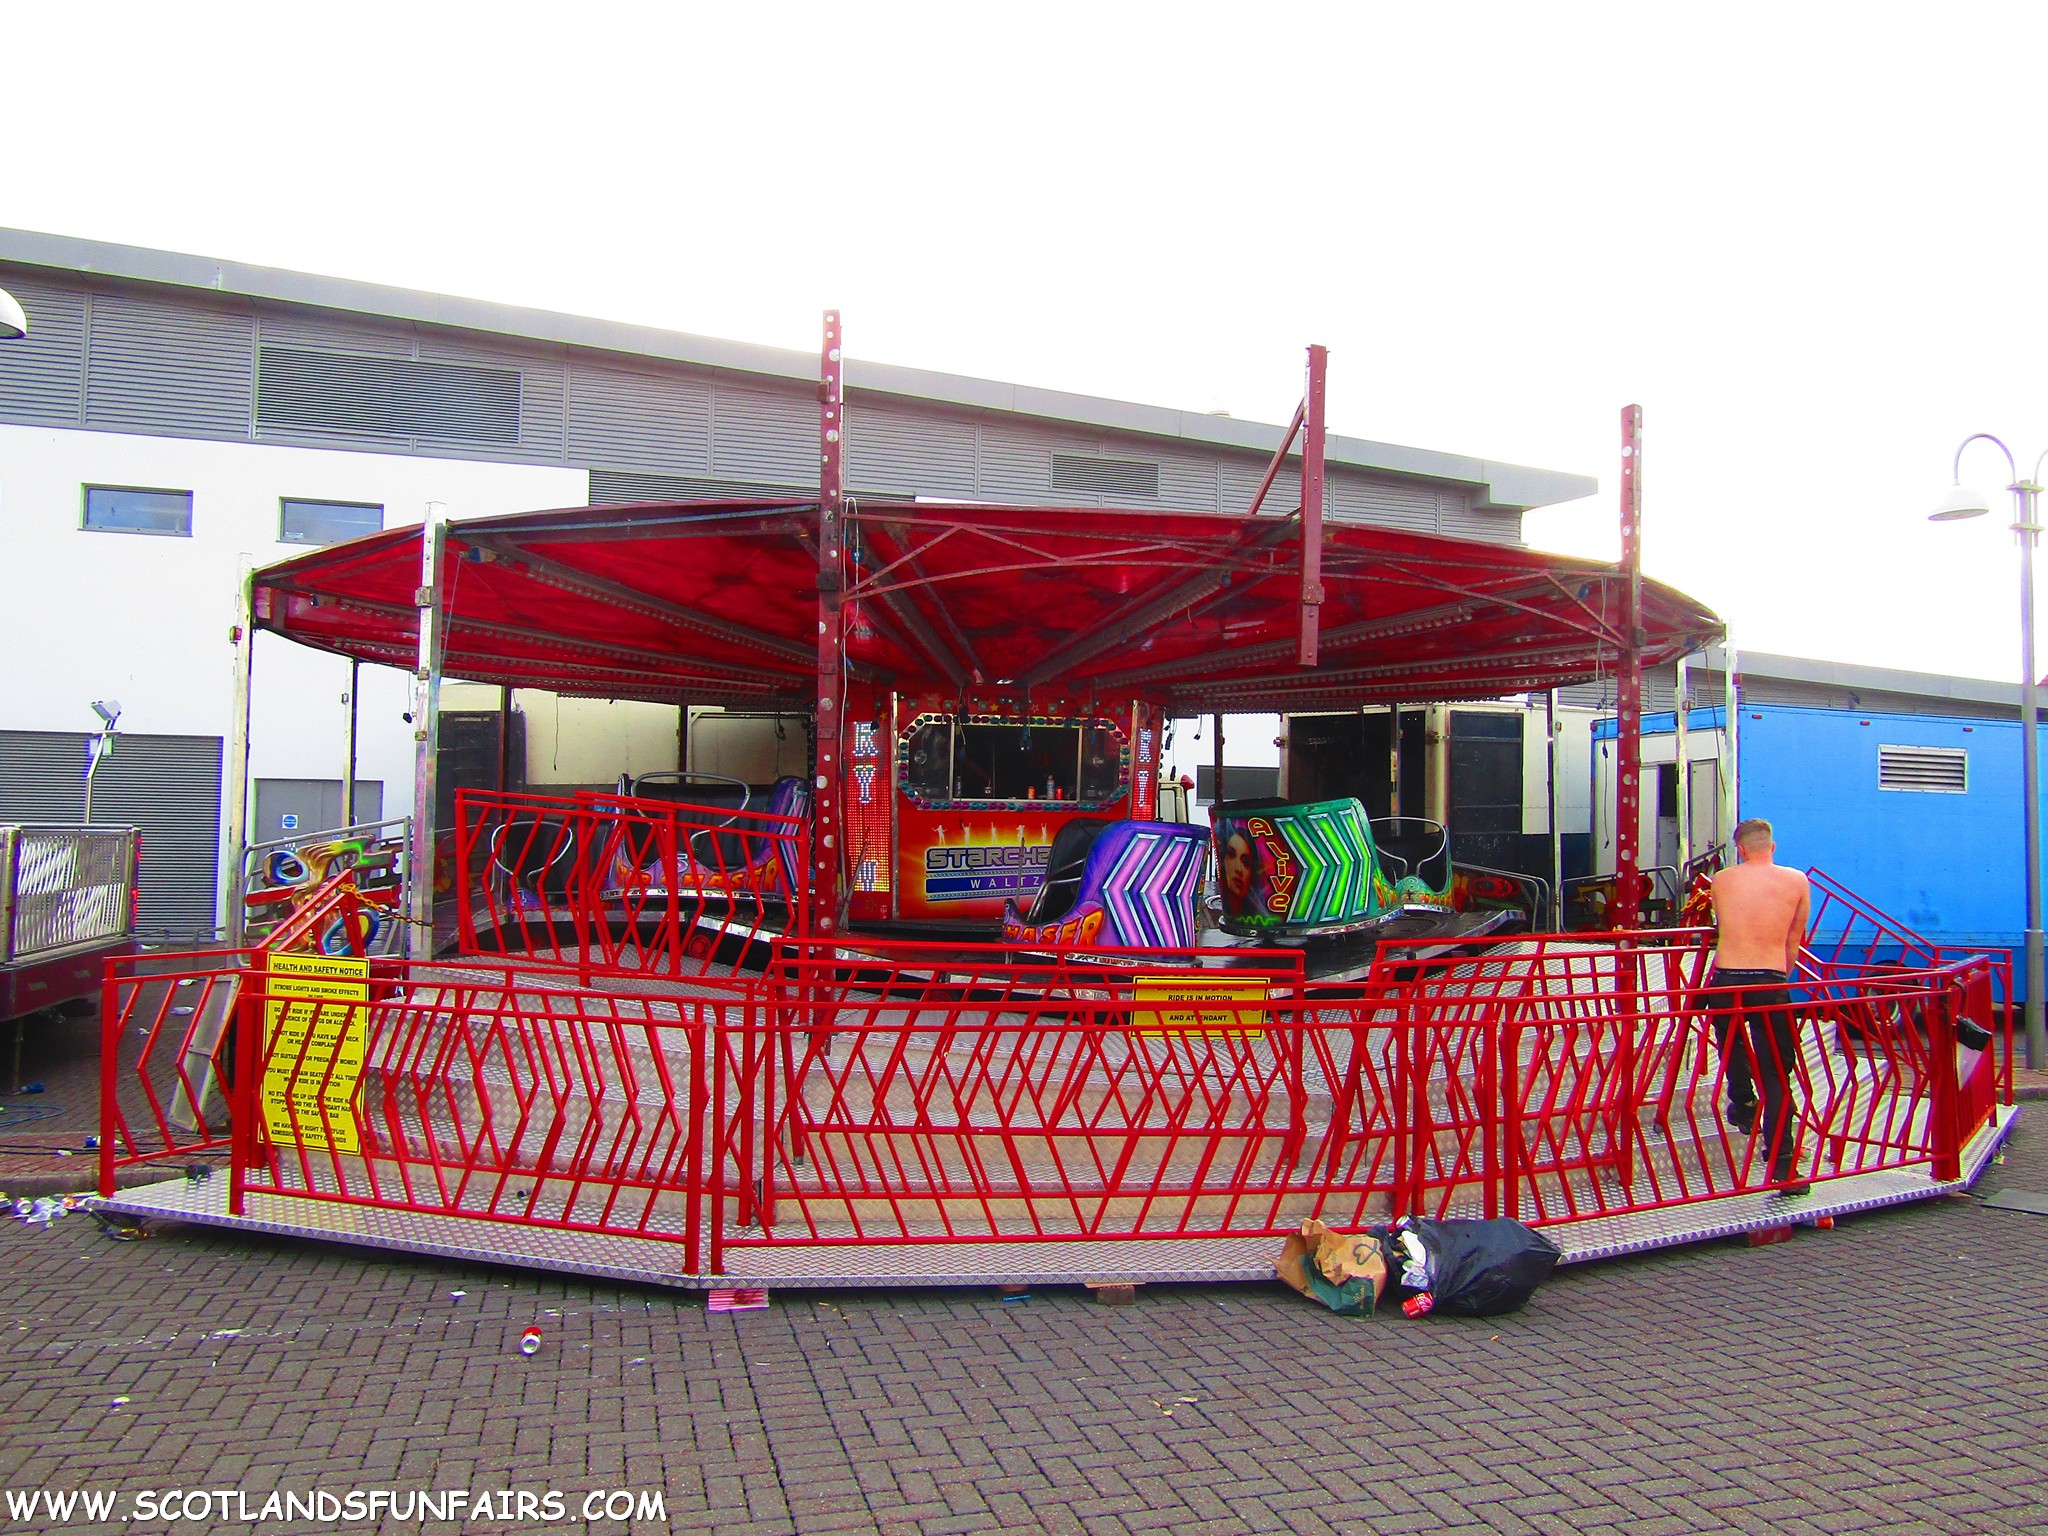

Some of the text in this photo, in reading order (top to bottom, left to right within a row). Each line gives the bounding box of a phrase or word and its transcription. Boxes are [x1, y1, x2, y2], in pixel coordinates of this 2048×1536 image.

[1002, 907, 1105, 945] HASER
[299, 964, 312, 972] AND
[314, 966, 338, 974] SAFETY
[340, 967, 363, 976] NOTICE
[338, 988, 359, 996] EFFECTS
[271, 1129, 294, 1137] ADMISSIO
